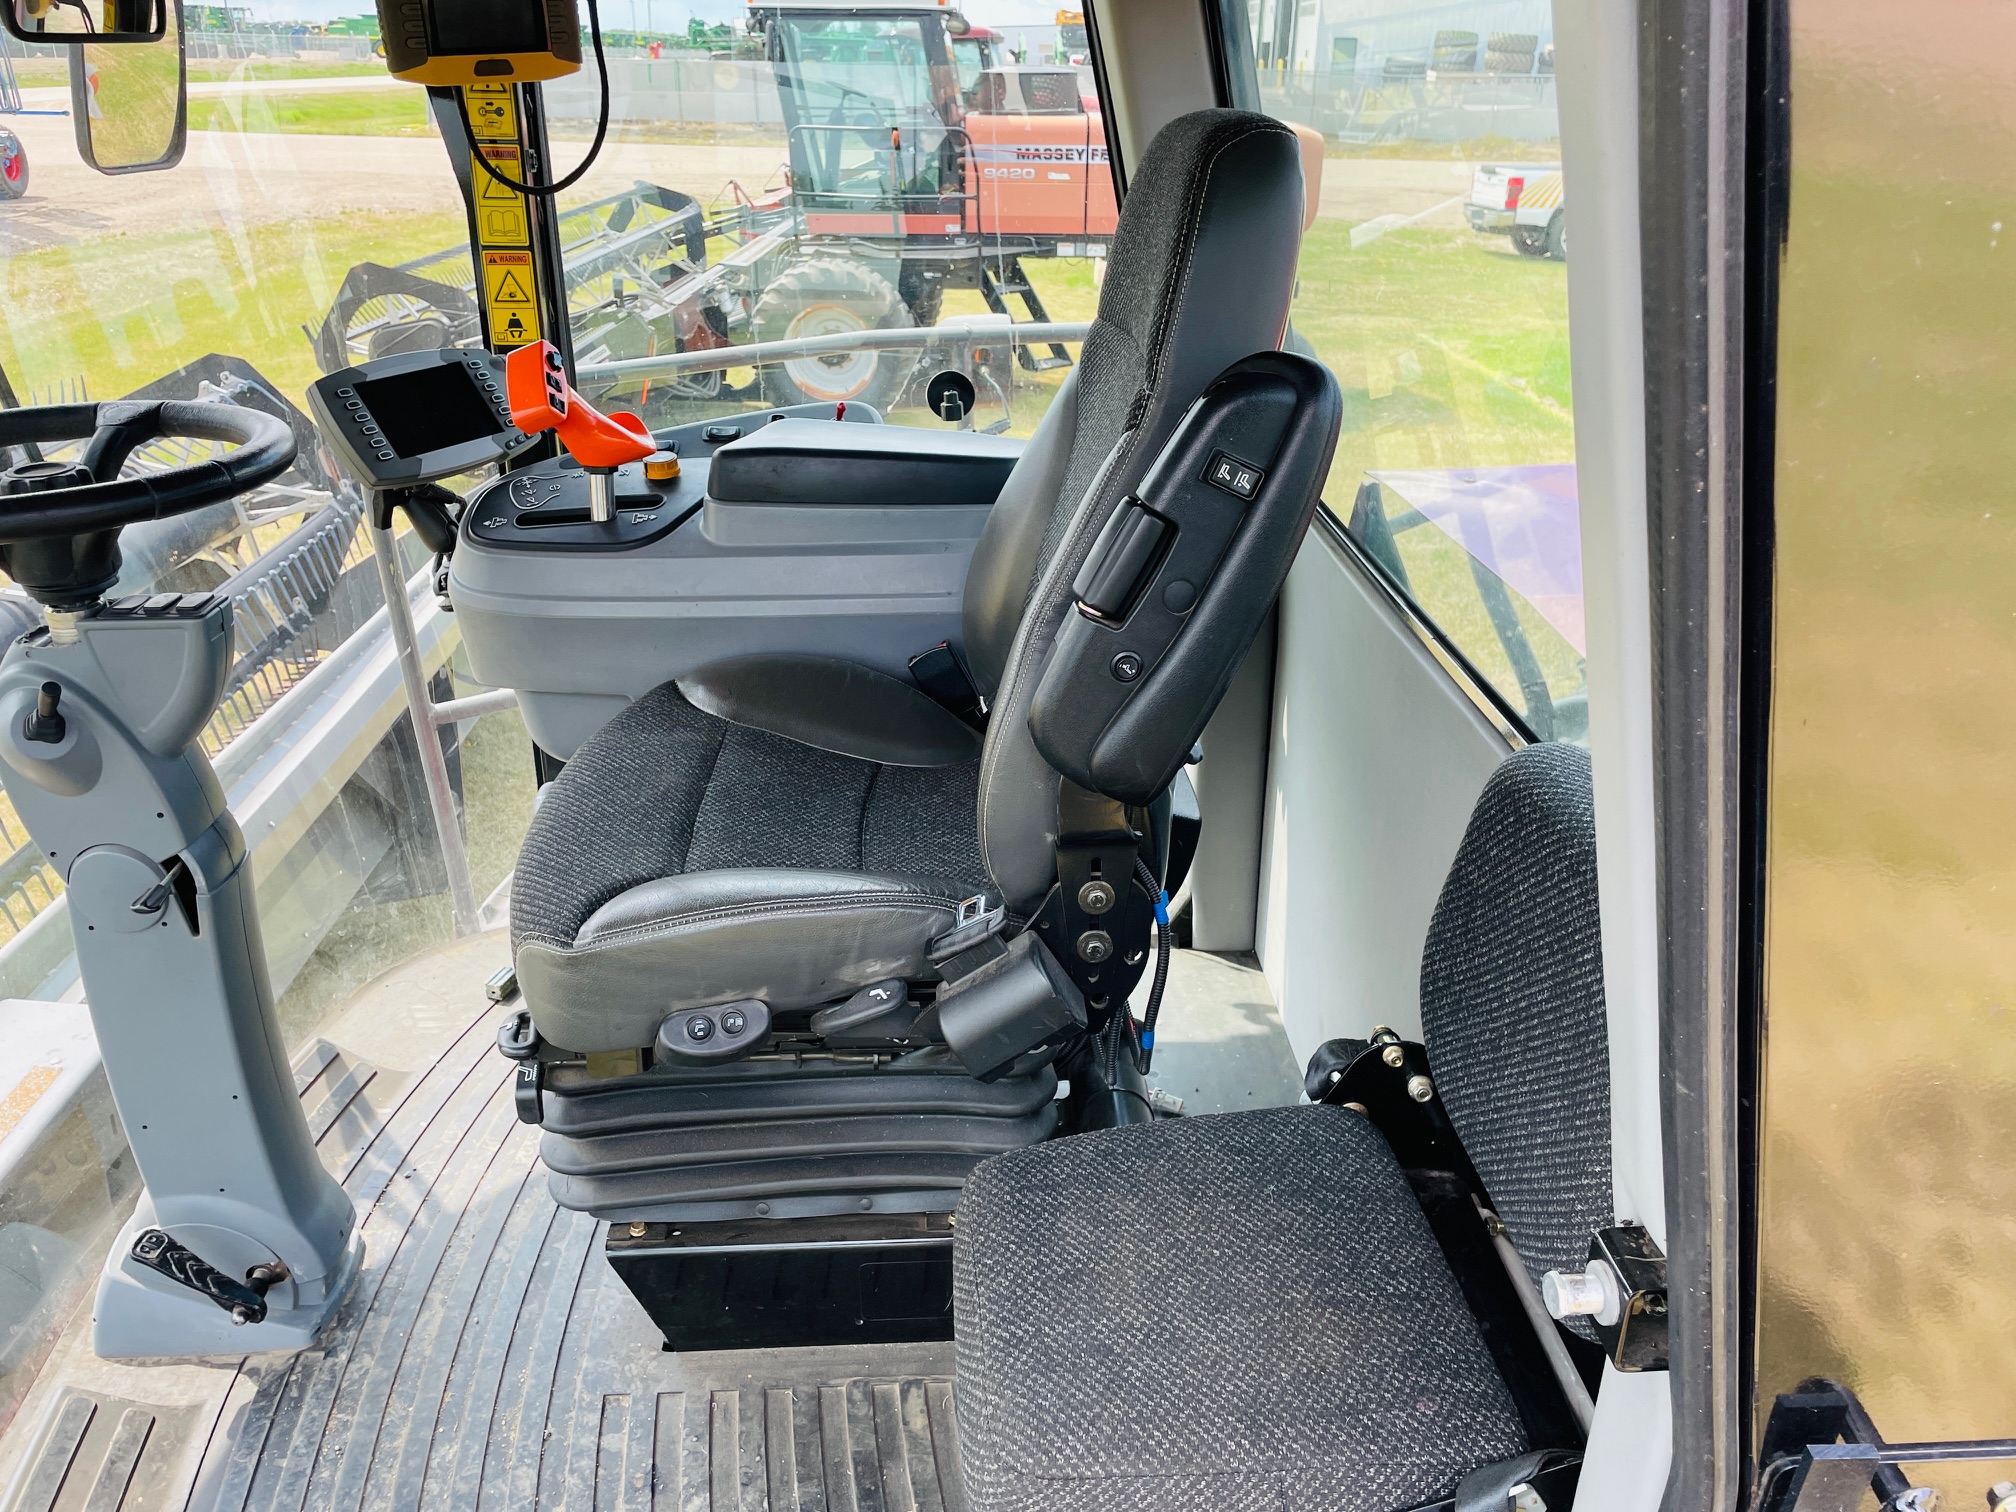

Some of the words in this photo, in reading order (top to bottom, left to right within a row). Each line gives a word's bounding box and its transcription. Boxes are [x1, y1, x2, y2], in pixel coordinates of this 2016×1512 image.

[484, 150, 517, 158] WARNING
[1016, 148, 1085, 160] MASSEY
[983, 167, 1035, 179] 9420
[499, 255, 527, 263] WARNING
